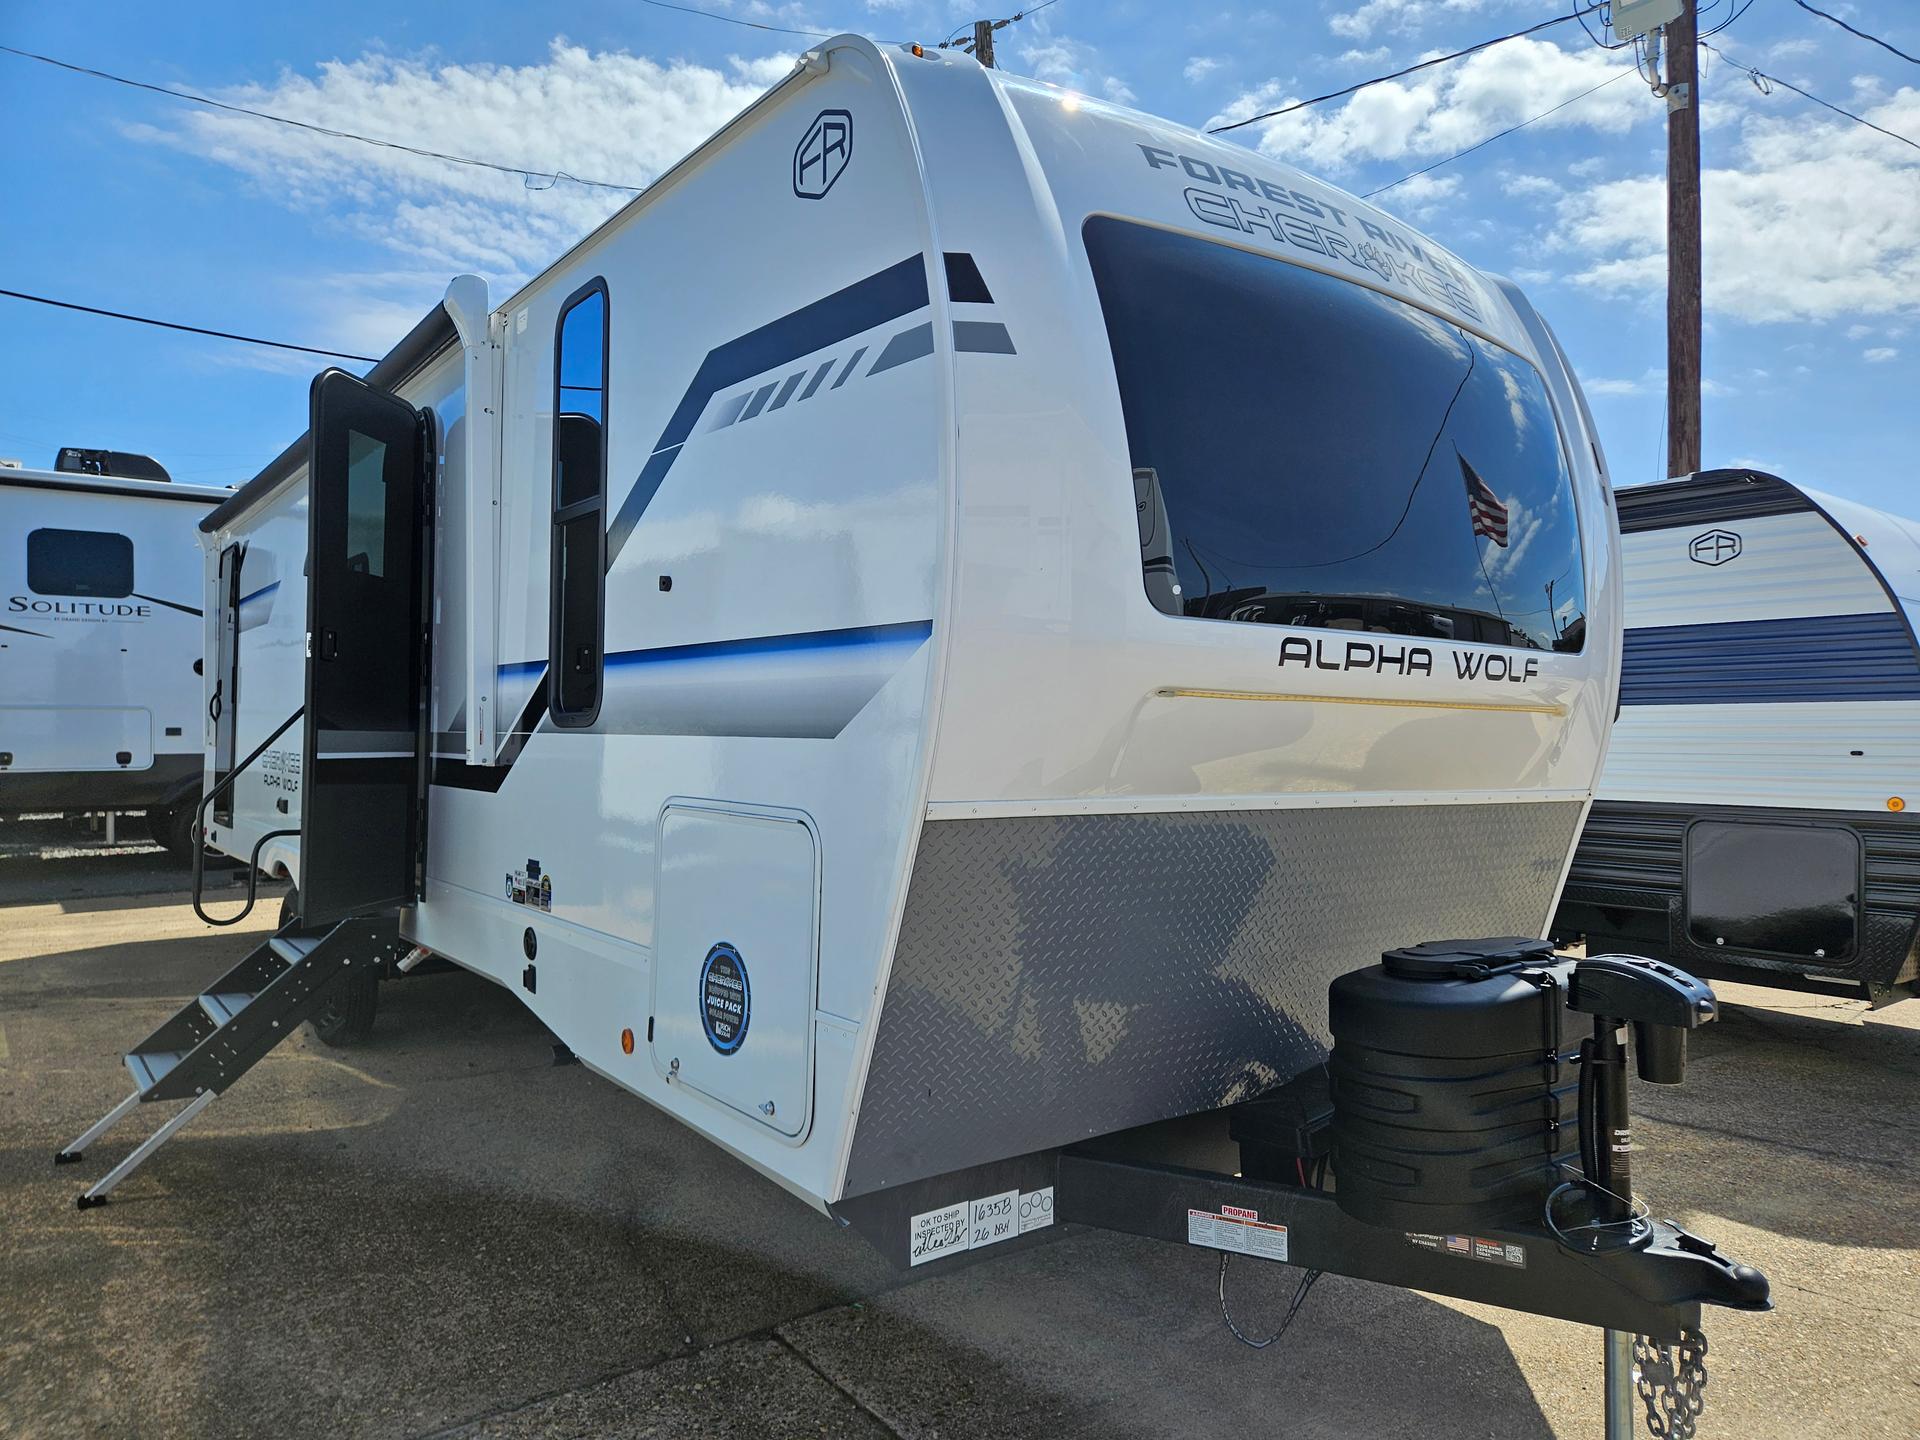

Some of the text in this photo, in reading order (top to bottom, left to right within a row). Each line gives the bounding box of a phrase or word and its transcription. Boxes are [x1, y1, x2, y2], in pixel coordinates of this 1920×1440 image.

[1136, 143, 1476, 294] FOREST RIVER
[8, 596, 151, 617] SOLITUDE
[1278, 637, 1538, 683] ALPHA WOLF
[707, 995, 742, 1014] JUICE PACK
[920, 1209, 960, 1228] OK TO SHIP
[1223, 1206, 1257, 1219] PROPANE
[914, 1219, 965, 1241] INSPECTED BY
